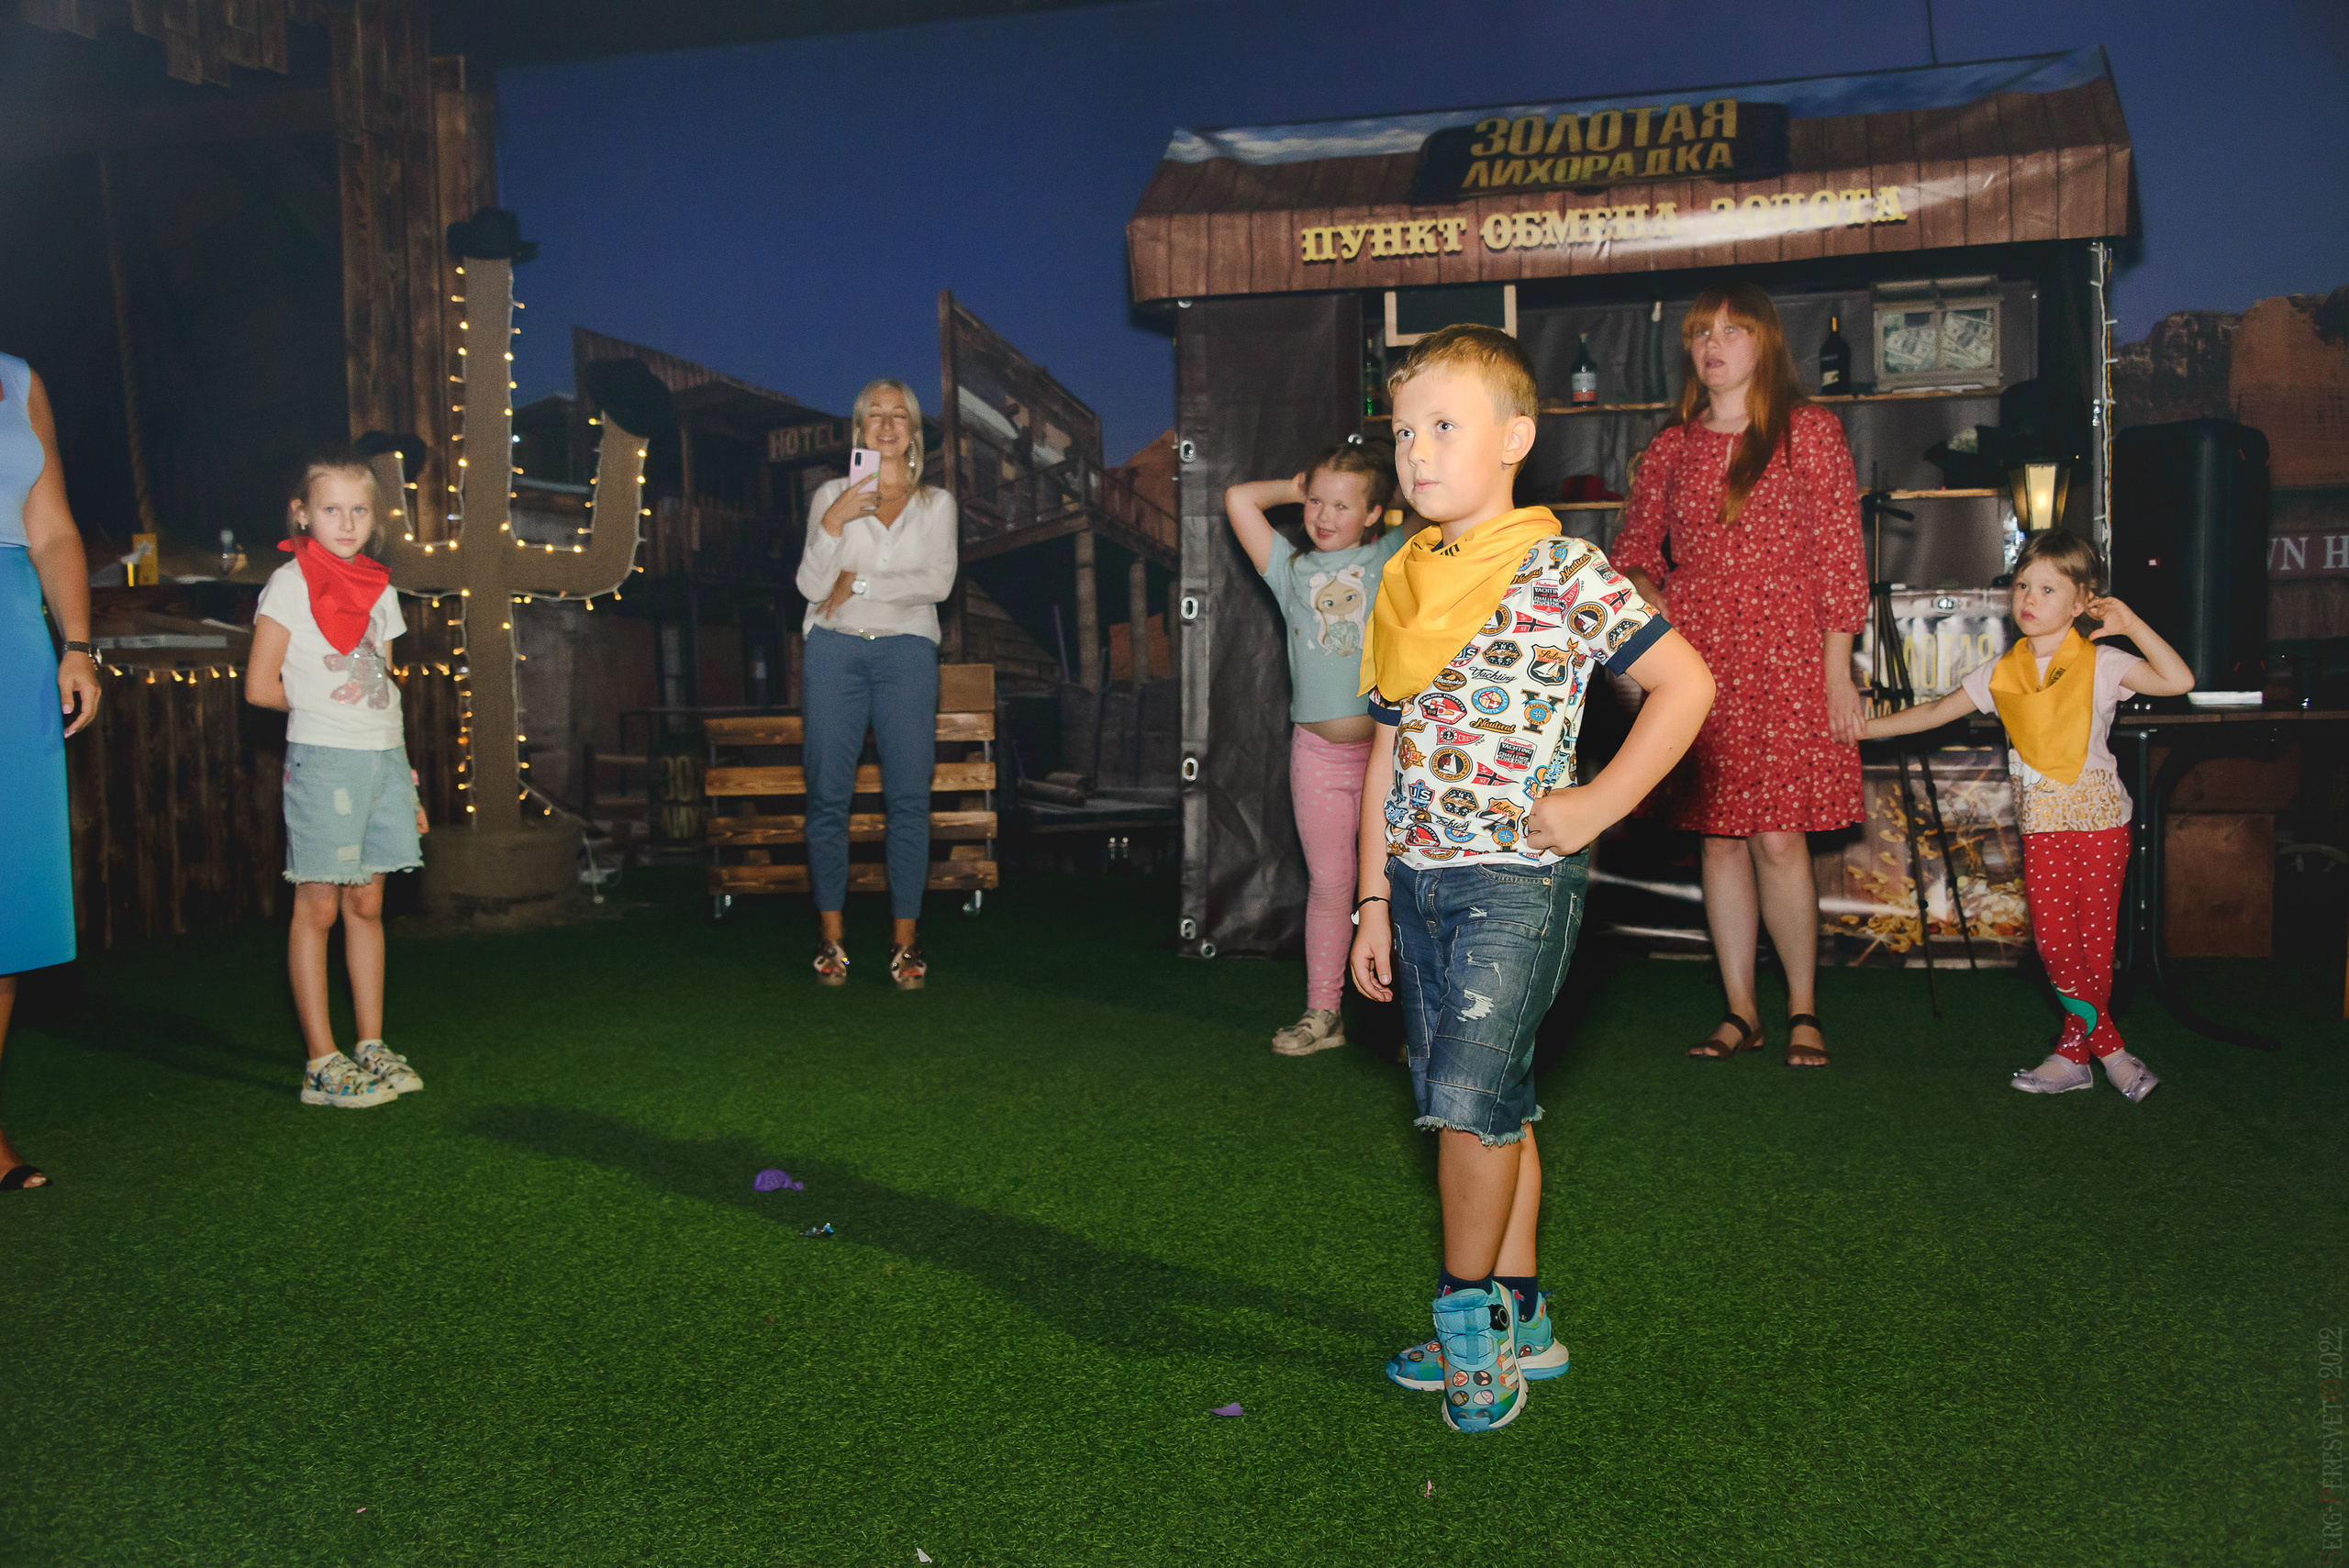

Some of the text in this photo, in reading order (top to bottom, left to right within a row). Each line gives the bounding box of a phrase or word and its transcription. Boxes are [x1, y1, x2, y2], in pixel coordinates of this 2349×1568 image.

[1471, 97, 1738, 157] ЗОЛОТАЯ
[1460, 142, 1734, 188] ЛИХОРАДКА
[1301, 186, 1908, 262] ПУНКТ ОБМЕНА ЗОЛОТА
[771, 424, 842, 460] HOTEL
[1469, 666, 1518, 684] Yachting
[1469, 717, 1517, 735] Nautical
[1501, 742, 1532, 754] YACHTING
[1409, 786, 1431, 800] US
